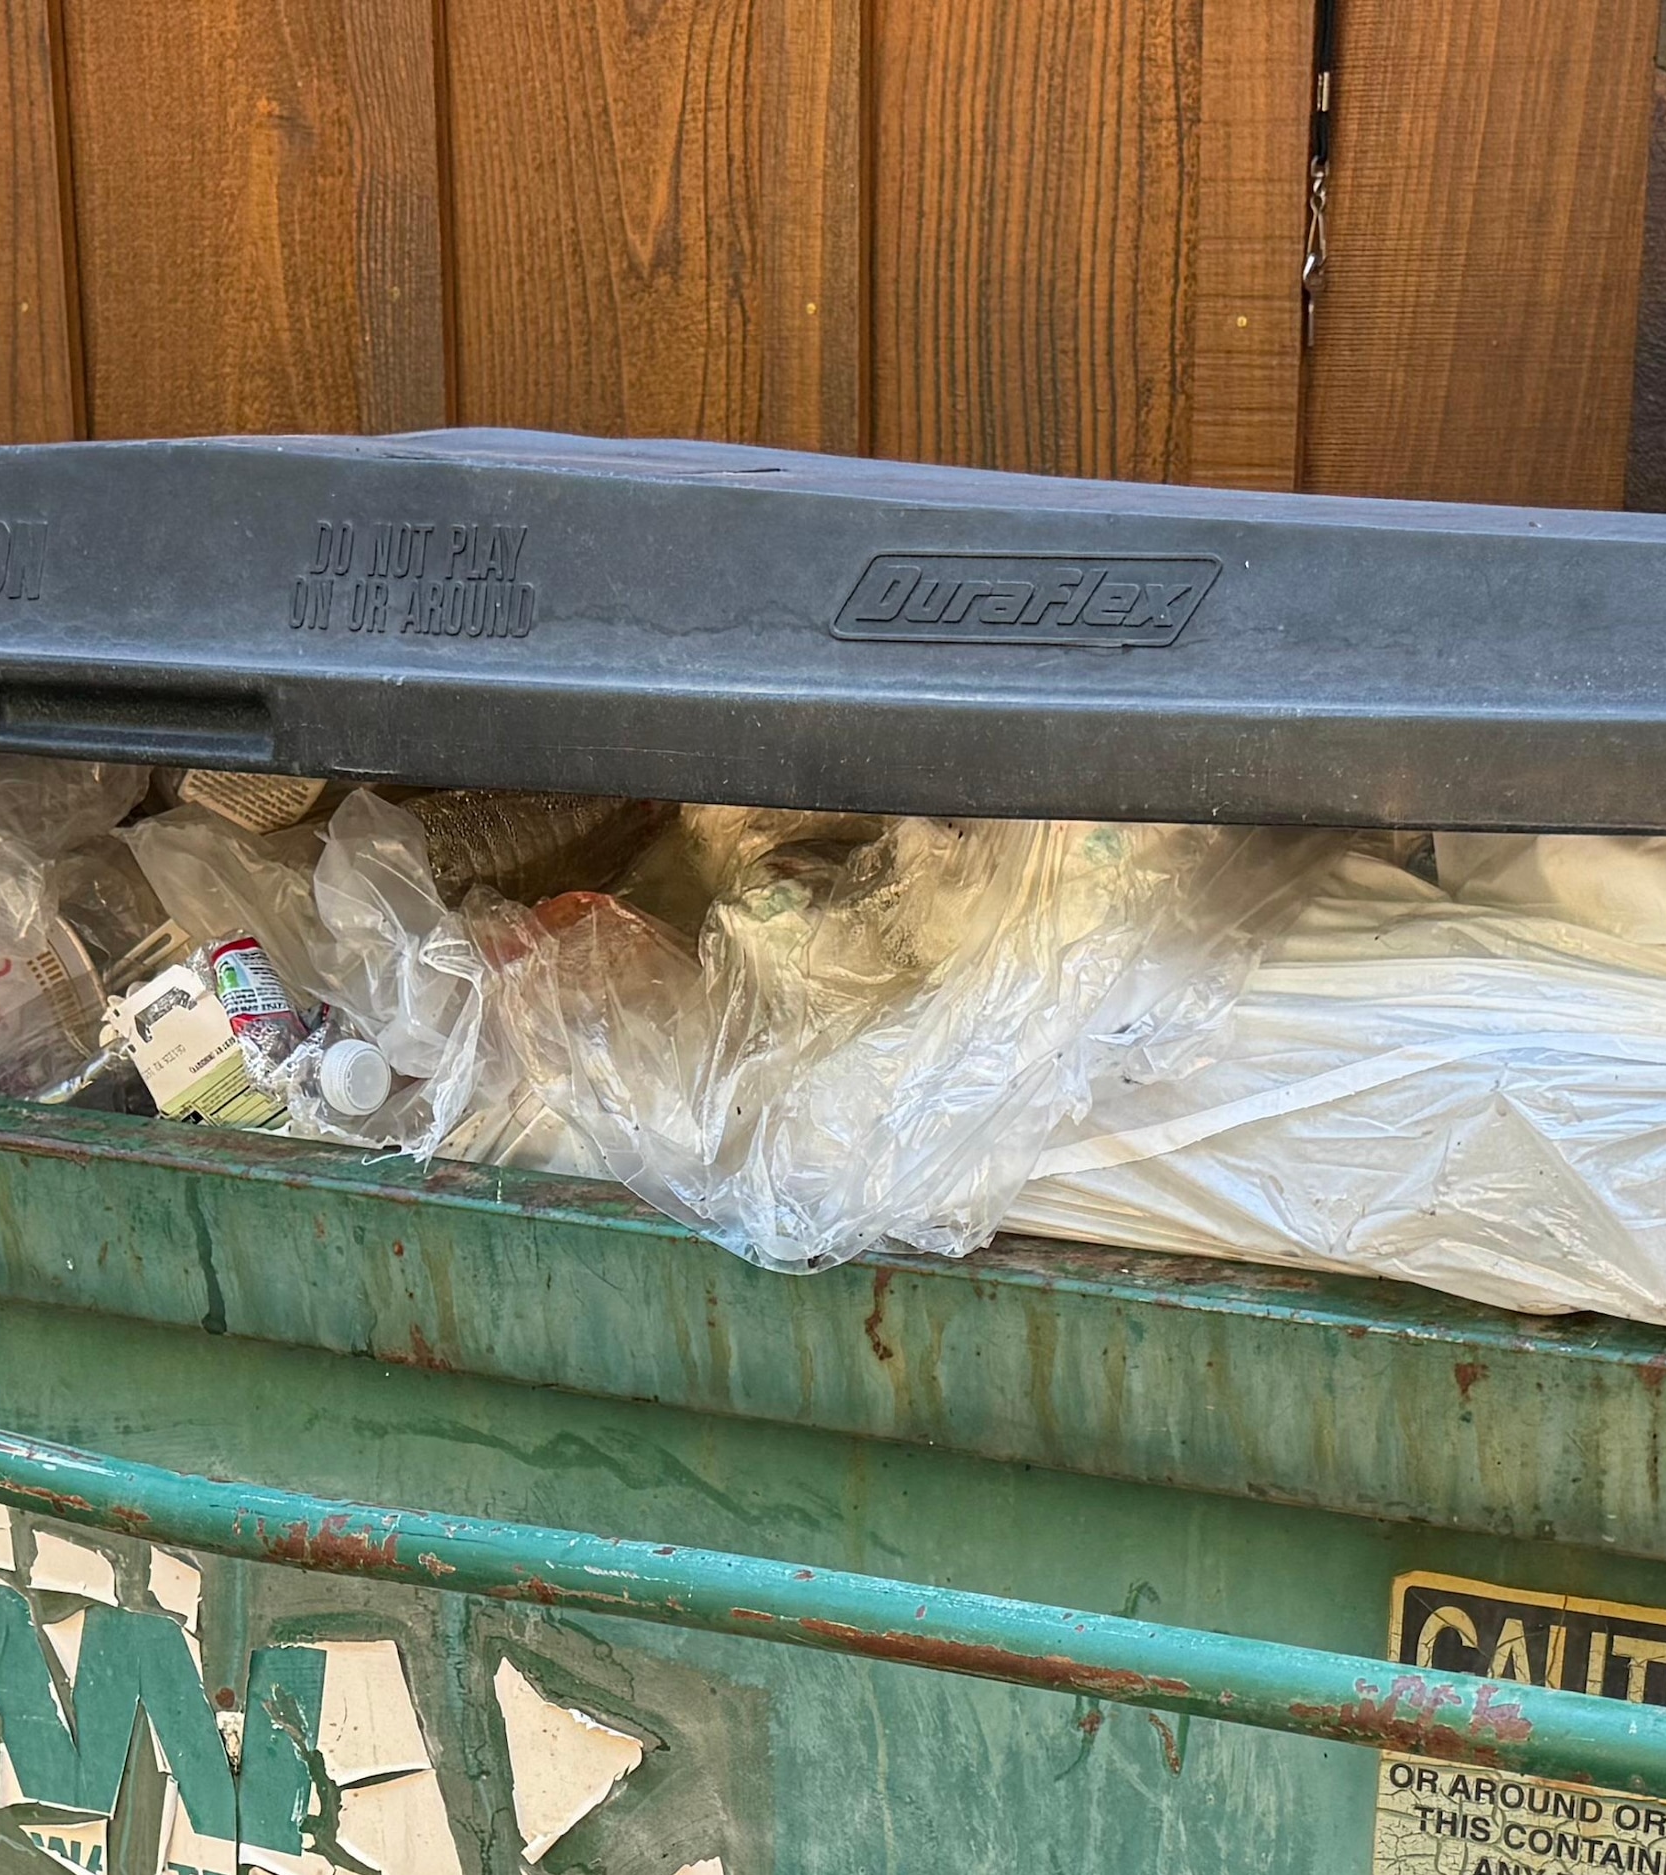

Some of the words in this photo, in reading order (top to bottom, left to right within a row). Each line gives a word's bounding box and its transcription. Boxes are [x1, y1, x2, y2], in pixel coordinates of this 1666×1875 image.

[310, 520, 354, 576] DO
[367, 522, 435, 578] NOT
[445, 524, 529, 581] PLAY
[289, 576, 334, 629] ON
[348, 577, 389, 633] OR
[400, 580, 535, 638] AROUND
[1389, 1762, 1439, 1794] OR
[1448, 1774, 1603, 1824] AROUND
[1615, 1804, 1666, 1836] OR
[1414, 1805, 1491, 1843] THIS
